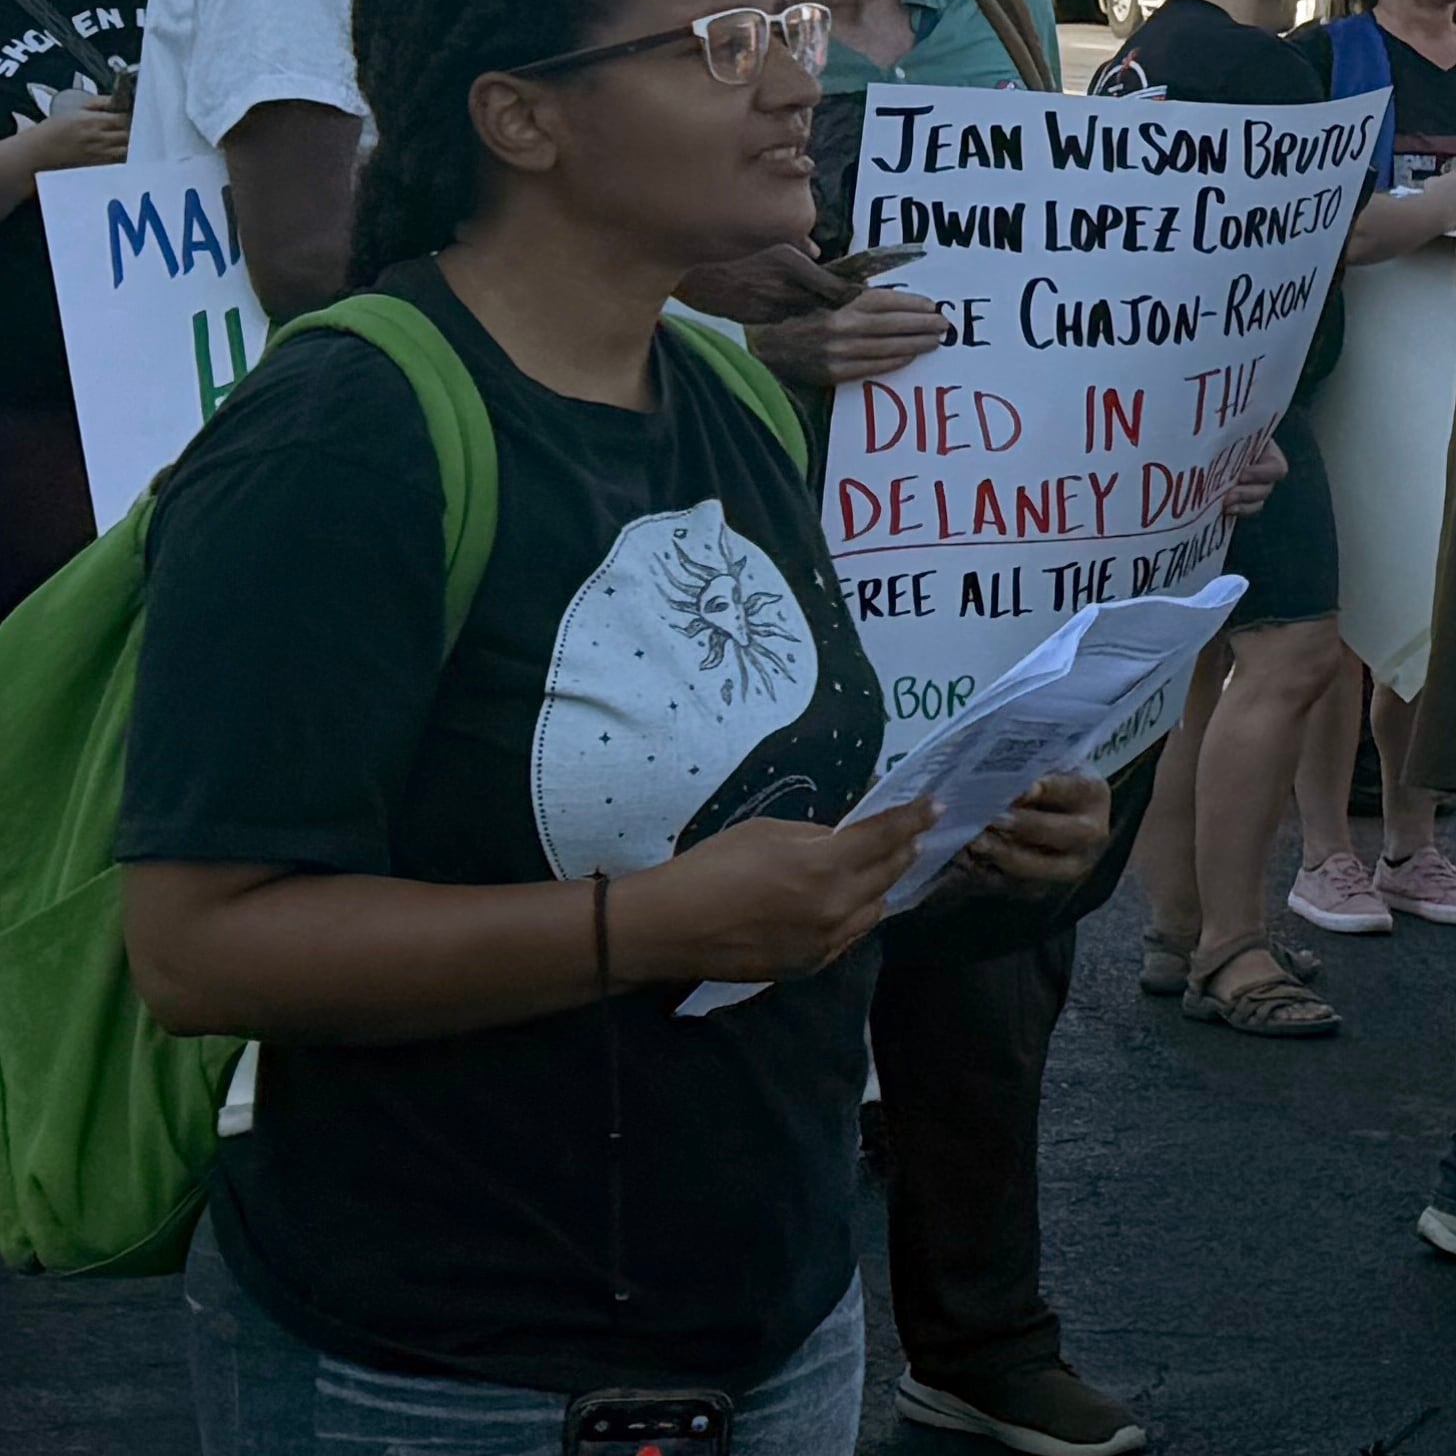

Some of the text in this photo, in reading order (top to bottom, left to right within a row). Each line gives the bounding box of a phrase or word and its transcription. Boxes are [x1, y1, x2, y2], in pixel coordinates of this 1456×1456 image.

[0, 7, 125, 78] SHOEN
[870, 103, 1024, 175] JEAN
[1044, 110, 1228, 176] WILSON
[1243, 114, 1374, 182] BRUTUS
[867, 184, 1344, 254] EDWIN LOPEZ CORNEJO
[1019, 266, 1318, 349] CHAJON-RAXON
[862, 355, 1265, 456] DIED IN THE
[838, 471, 1118, 541] DELANEY
[959, 566, 1032, 618] ALL
[1042, 556, 1117, 612] THE
[892, 674, 976, 721] BOR
